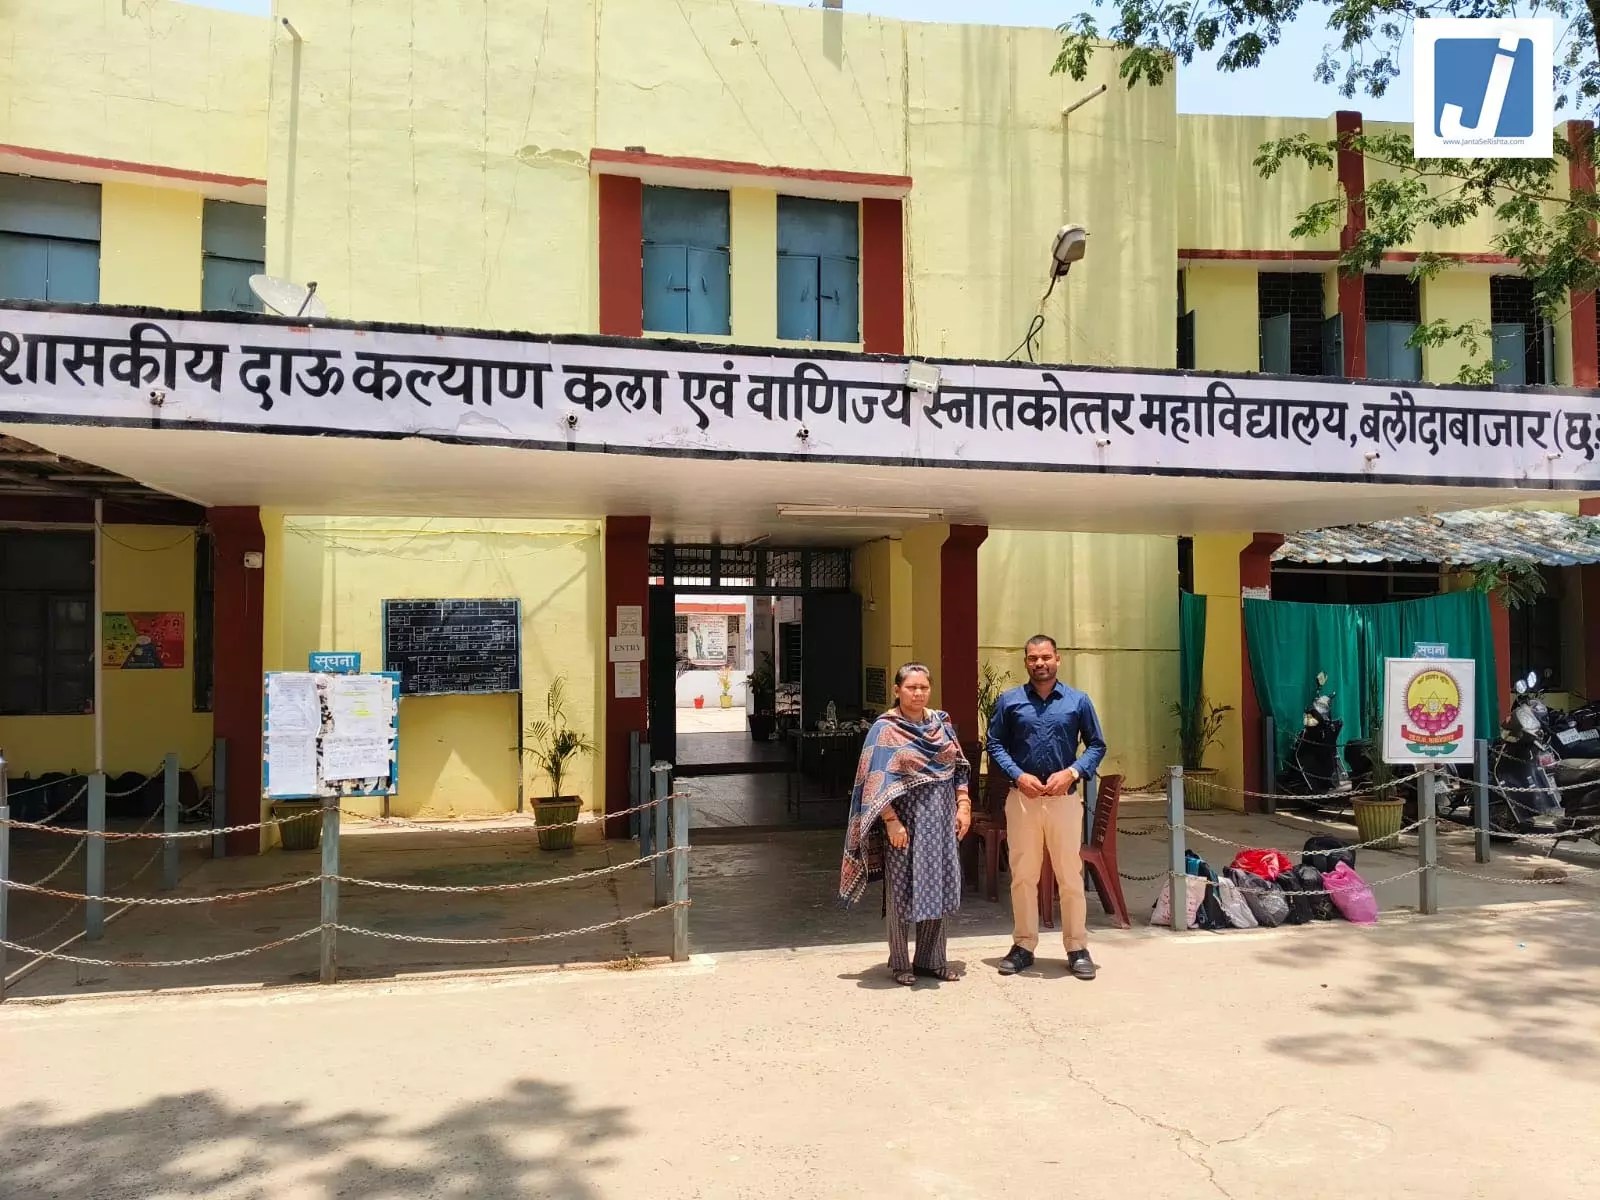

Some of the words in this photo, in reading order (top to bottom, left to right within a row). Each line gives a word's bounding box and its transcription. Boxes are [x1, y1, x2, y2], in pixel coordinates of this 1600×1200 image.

[0, 323, 229, 393] शासकीय
[240, 345, 342, 410] दाऊ
[352, 351, 554, 409] कल्याण
[561, 365, 668, 415] कला
[678, 360, 740, 430] एवं
[747, 362, 914, 427] वाणिज्य
[923, 372, 1135, 436] स्नातकोत्तर
[614, 643, 641, 653] ENTRY
[314, 655, 356, 671] सूचना
